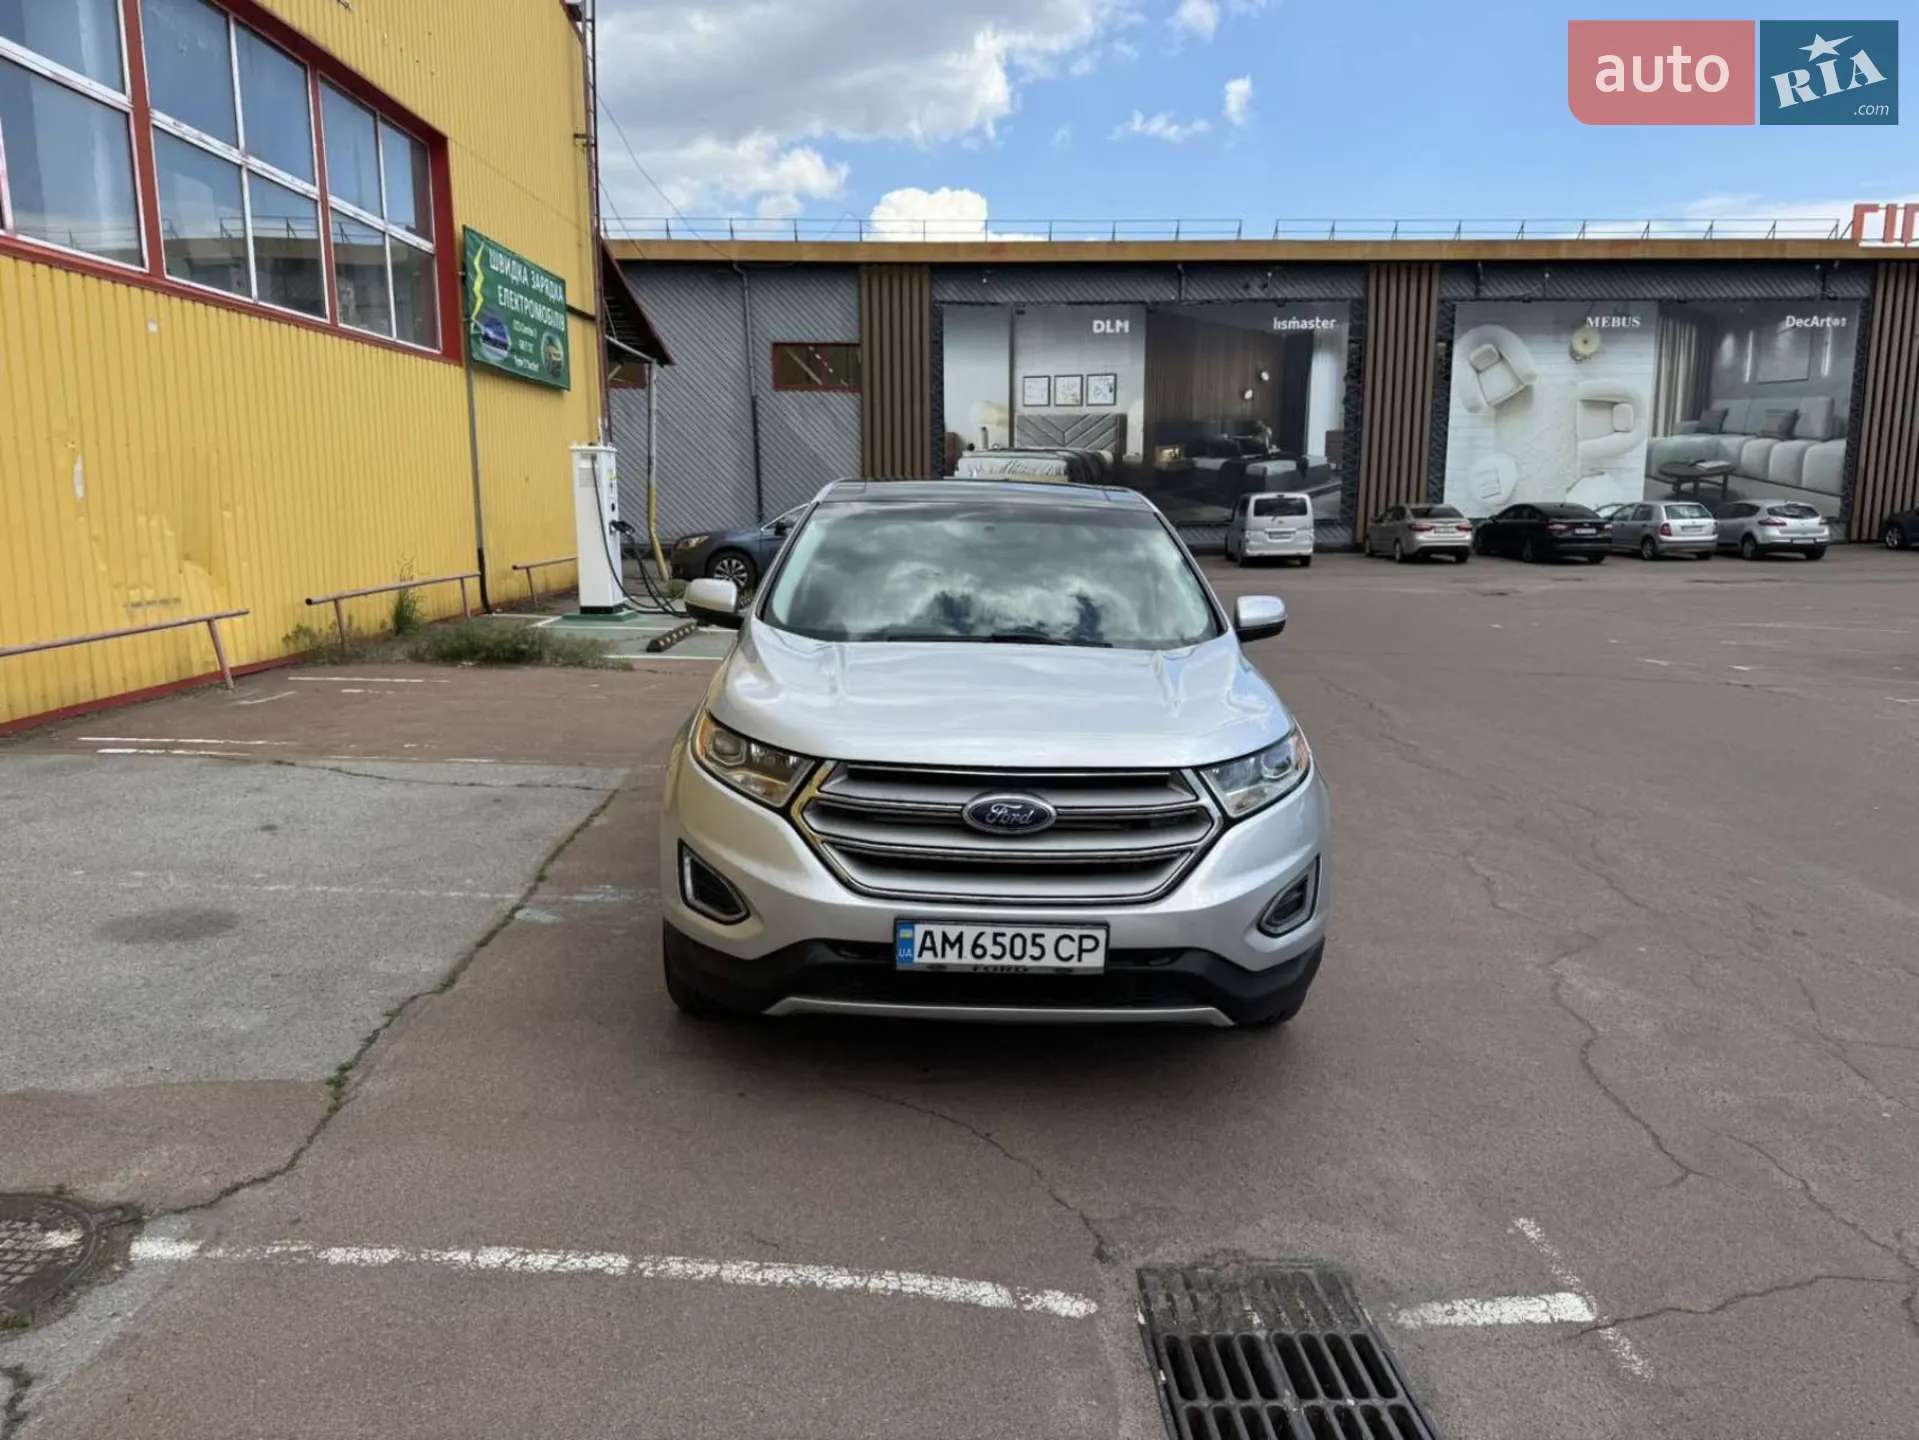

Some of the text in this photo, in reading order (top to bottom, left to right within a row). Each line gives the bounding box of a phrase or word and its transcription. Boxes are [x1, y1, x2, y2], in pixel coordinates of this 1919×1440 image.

[488, 248, 564, 303] ШВИДКА ЗАРЯДКА
[1092, 319, 1129, 334] DLM
[1585, 316, 1641, 328] MEBUS
[984, 802, 1034, 826] Ford
[898, 947, 913, 959] UA
[917, 930, 1100, 963] AM 6505 CP
